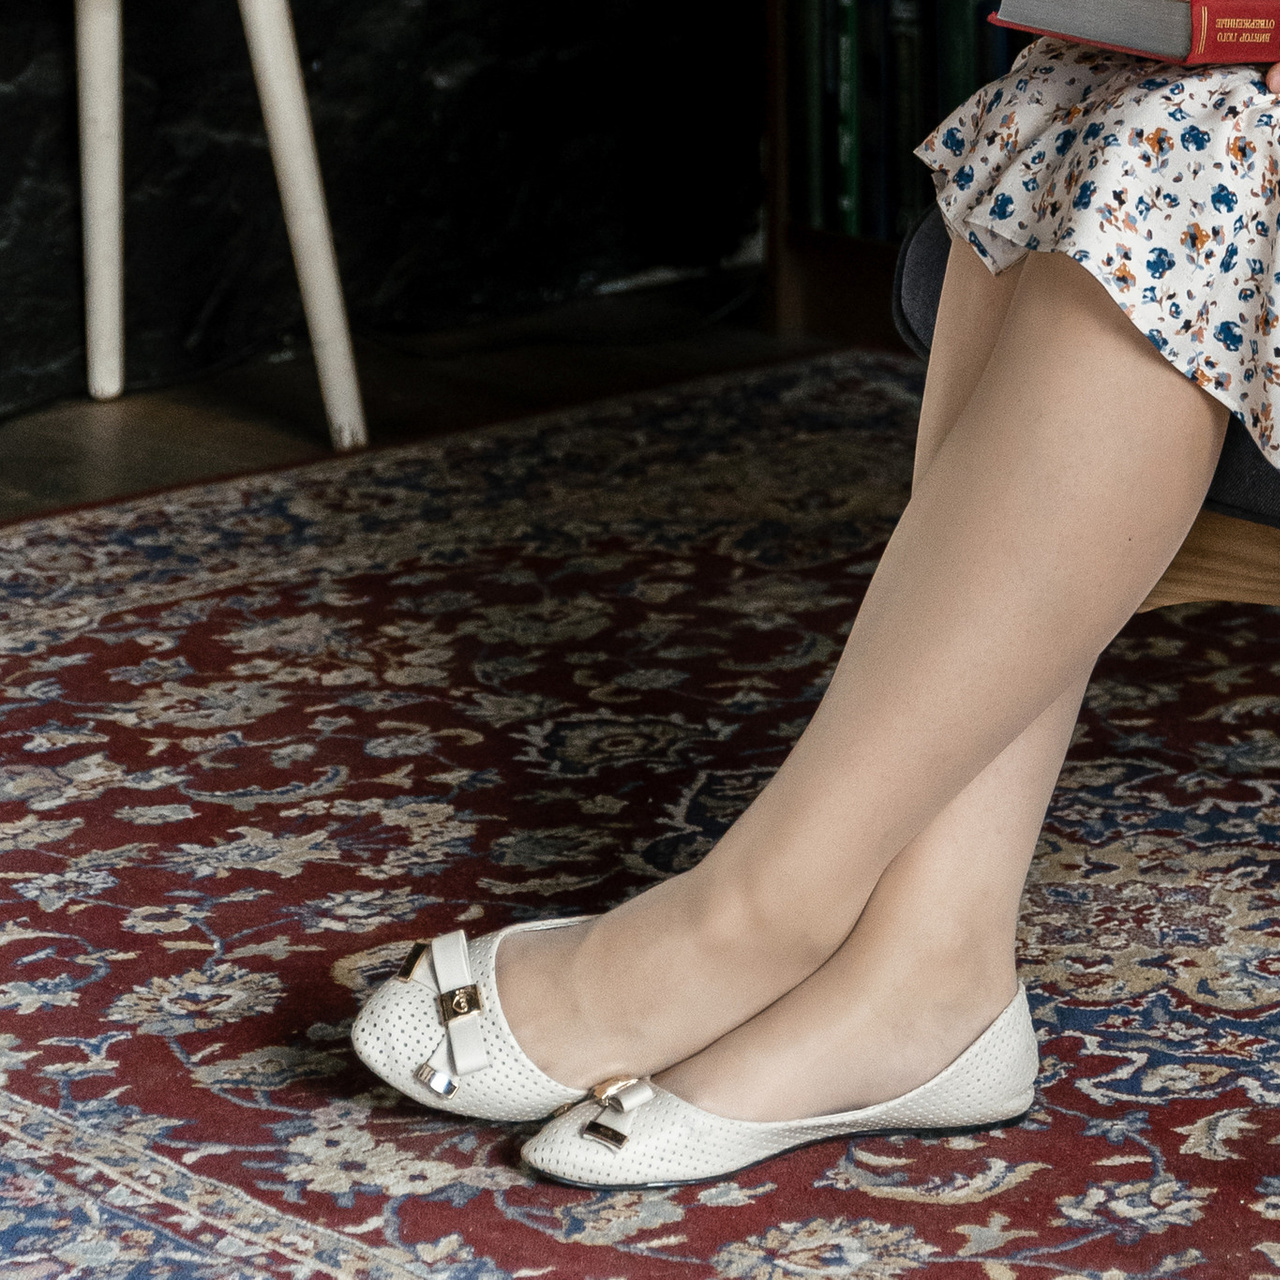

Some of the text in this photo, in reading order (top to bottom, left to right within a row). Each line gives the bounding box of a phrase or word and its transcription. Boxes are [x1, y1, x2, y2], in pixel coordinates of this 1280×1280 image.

[1215, 18, 1275, 29] ОТВЕРЖЕННЫЕ
[1217, 32, 1270, 43] ВИКТОР ГЮГО
